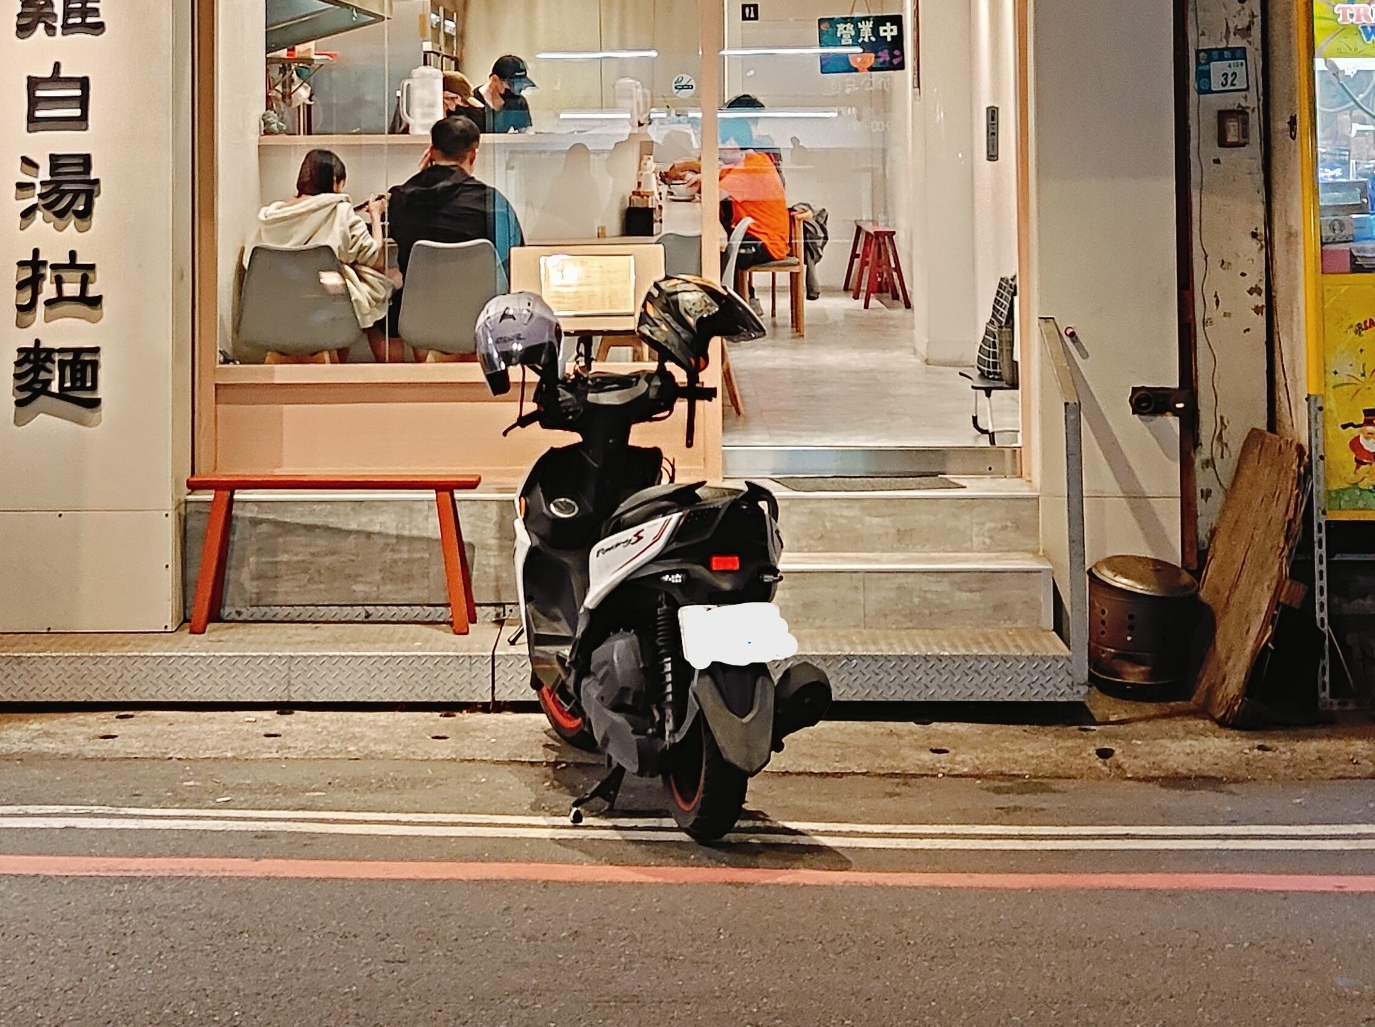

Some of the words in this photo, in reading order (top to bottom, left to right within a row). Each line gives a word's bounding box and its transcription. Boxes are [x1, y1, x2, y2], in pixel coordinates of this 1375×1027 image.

[836, 20, 898, 45] 營業中
[1221, 71, 1238, 88] 32
